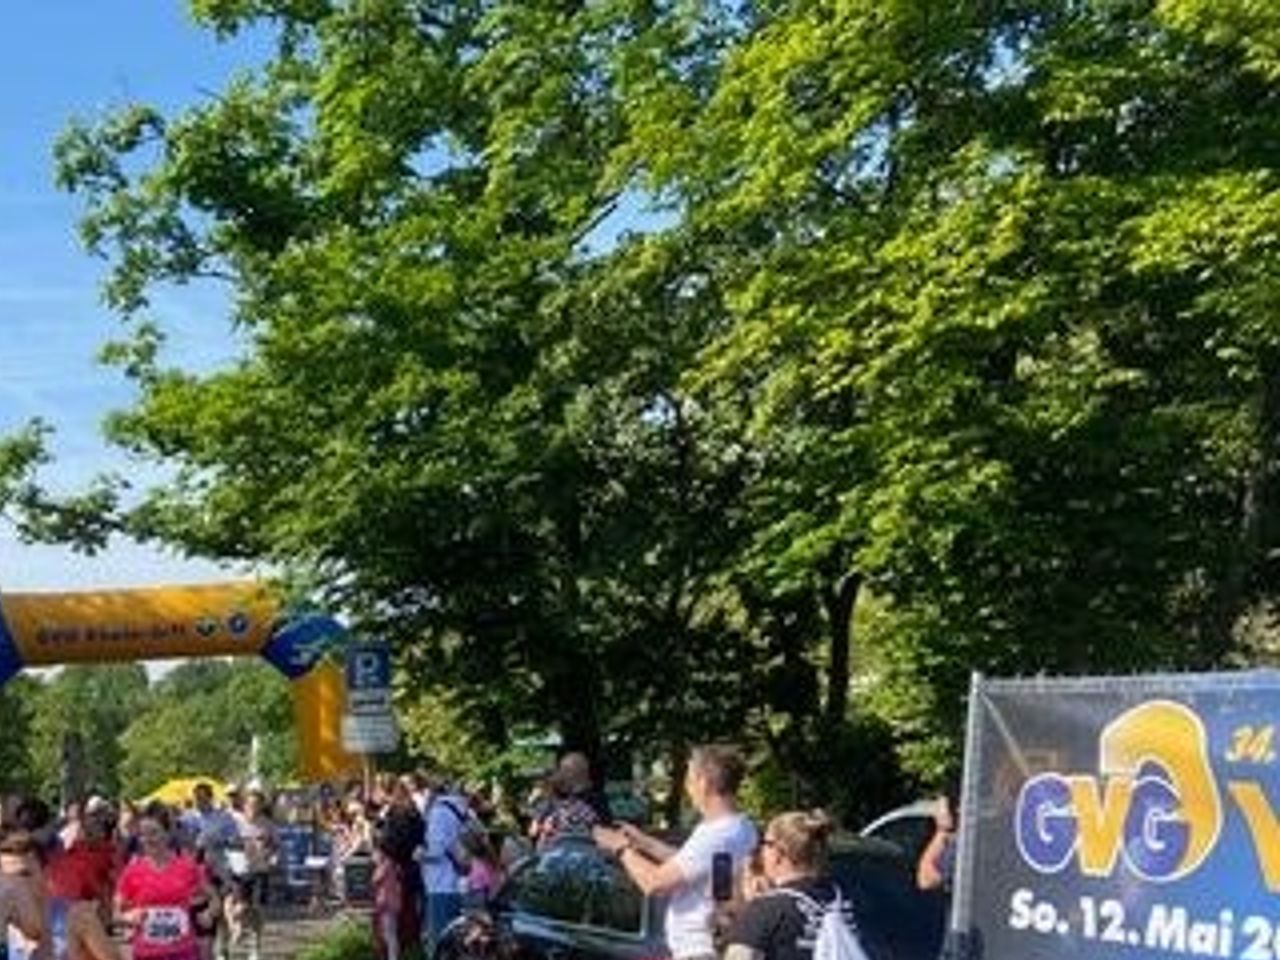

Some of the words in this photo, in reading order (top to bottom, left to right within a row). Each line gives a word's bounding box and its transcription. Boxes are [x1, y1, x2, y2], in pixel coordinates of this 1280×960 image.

[1015, 720, 1223, 883] GVG
[1008, 888, 1069, 935] So.
[1079, 896, 1141, 947] 12.
[1144, 903, 1234, 959] Mai
